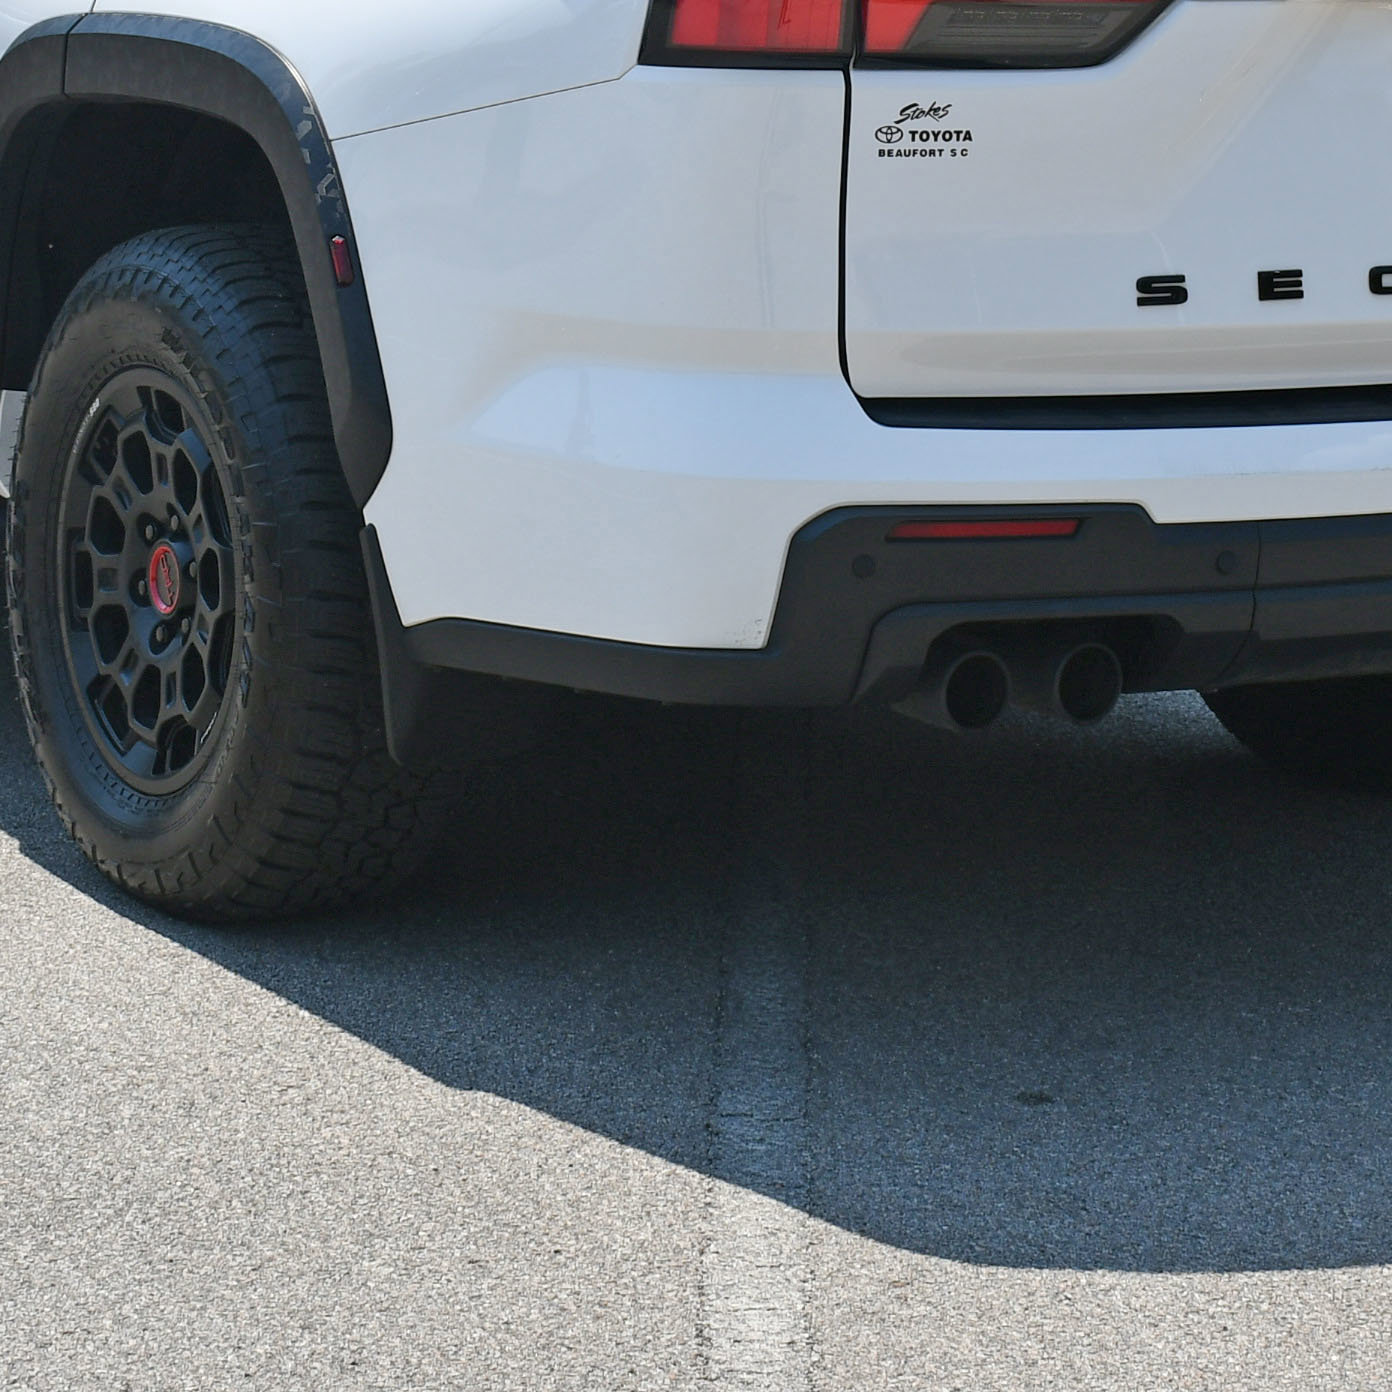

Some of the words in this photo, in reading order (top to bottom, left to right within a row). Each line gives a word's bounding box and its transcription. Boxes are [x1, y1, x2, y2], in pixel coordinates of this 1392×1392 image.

[894, 101, 952, 124] Stokes
[908, 130, 973, 143] TOYOTA
[878, 148, 945, 158] BEAUFORT
